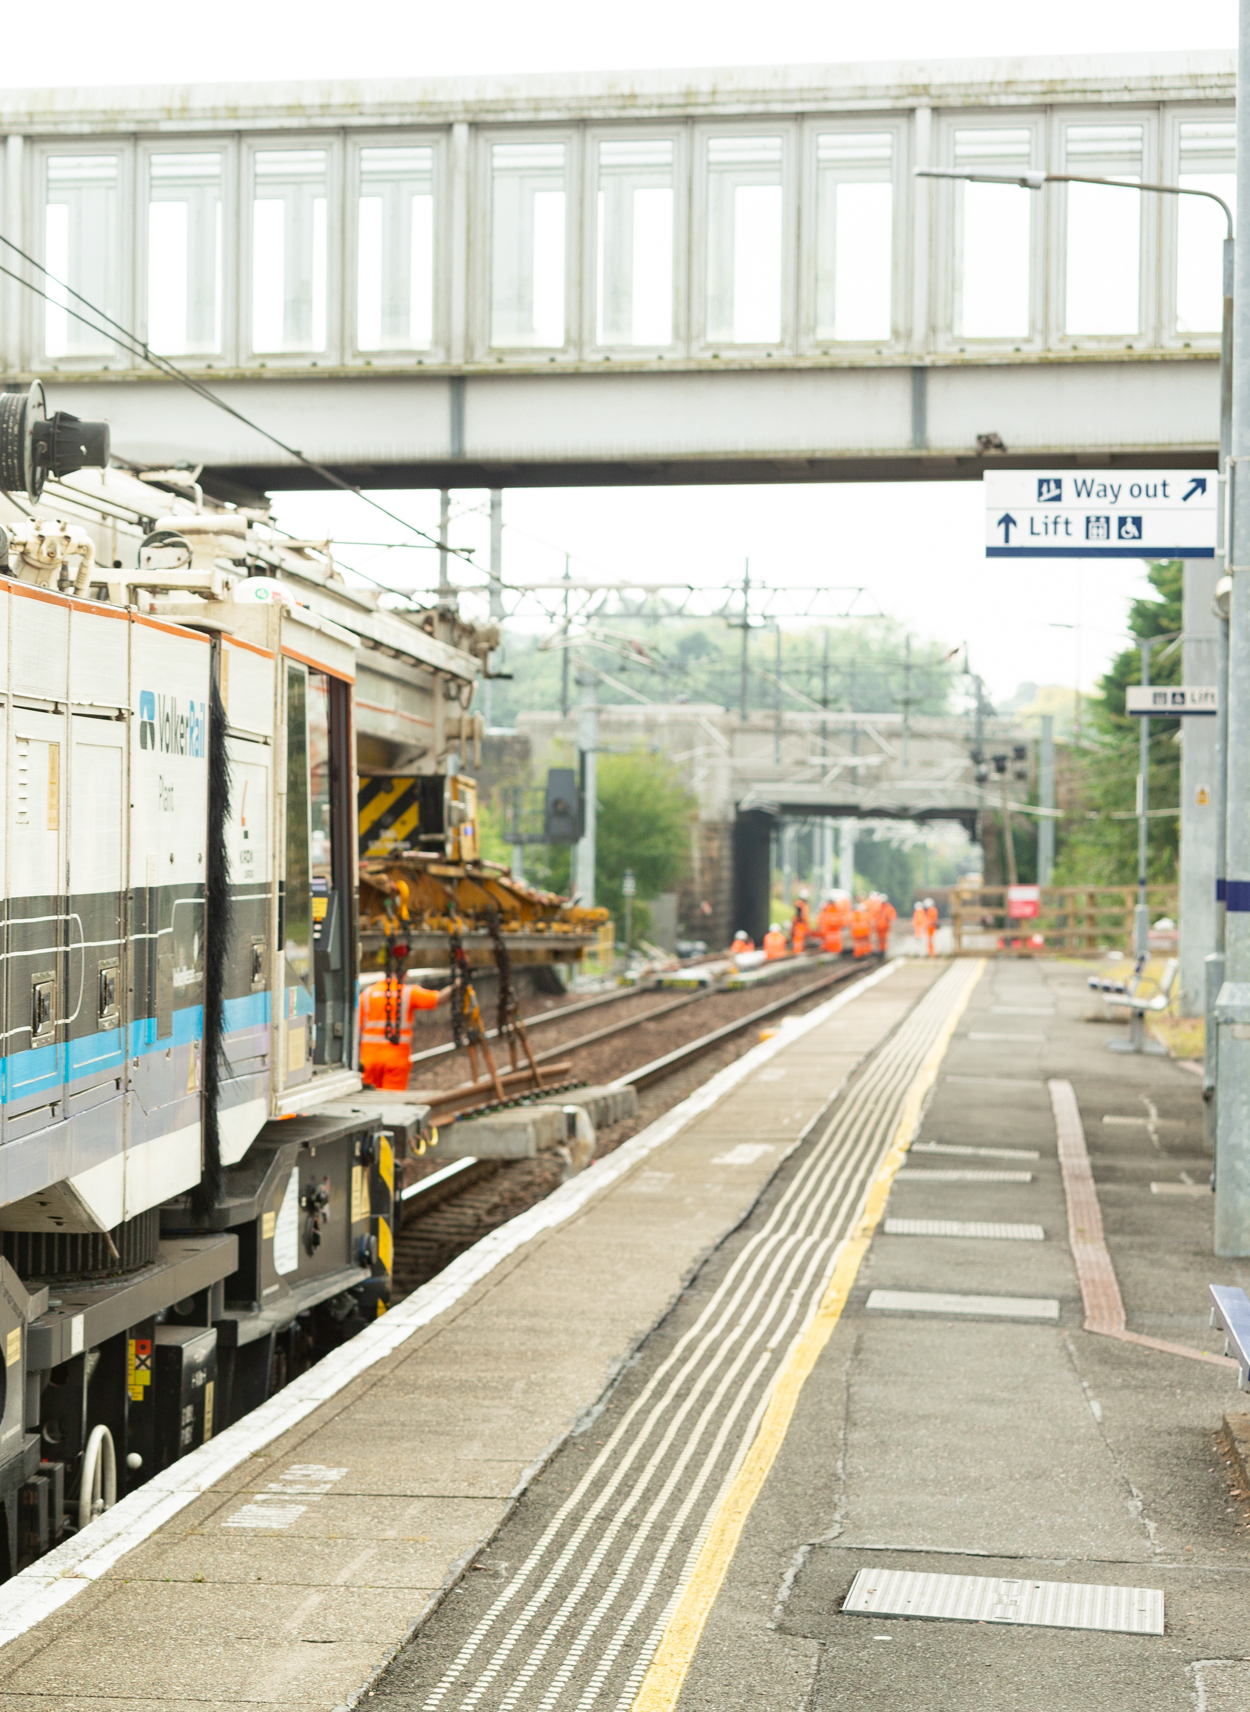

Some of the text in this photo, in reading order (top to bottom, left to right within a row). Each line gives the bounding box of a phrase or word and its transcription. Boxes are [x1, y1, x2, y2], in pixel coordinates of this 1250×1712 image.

[1074, 478, 1171, 504] Way out
[1030, 515, 1073, 536] Lift
[1190, 690, 1216, 704] Lift
[158, 693, 206, 758] VolkerRail
